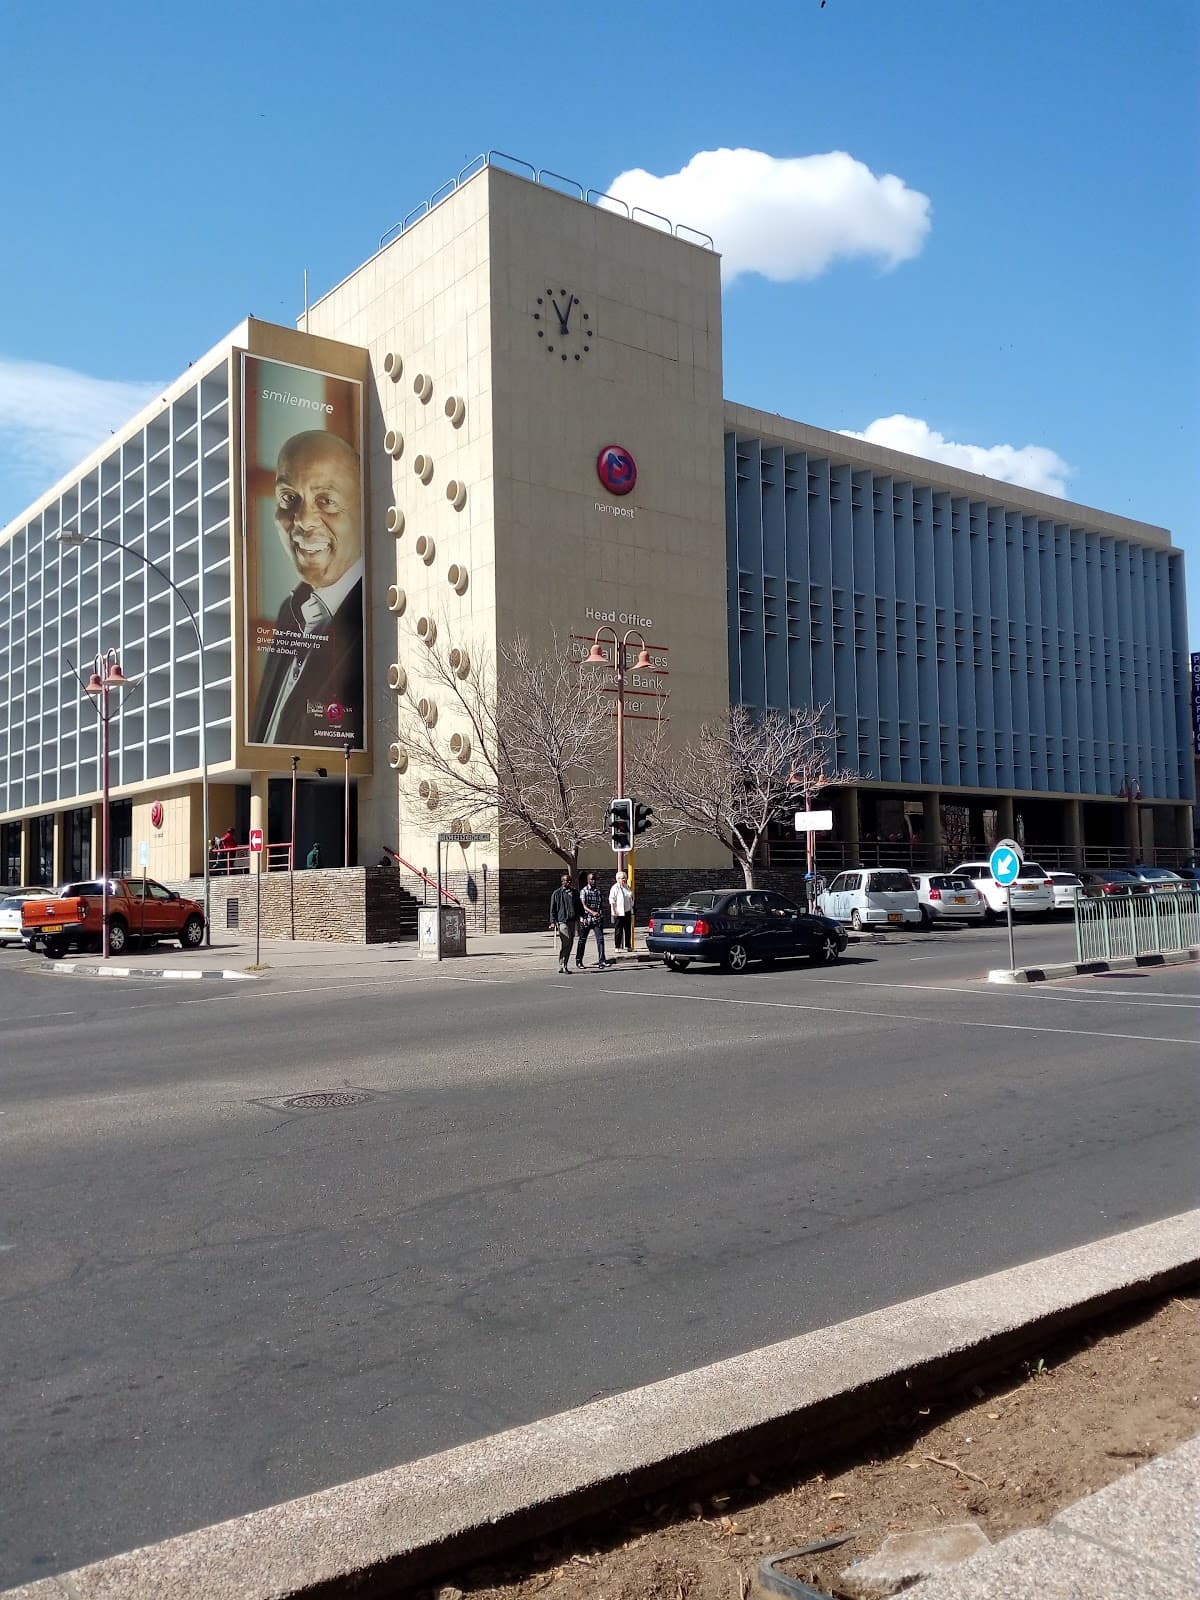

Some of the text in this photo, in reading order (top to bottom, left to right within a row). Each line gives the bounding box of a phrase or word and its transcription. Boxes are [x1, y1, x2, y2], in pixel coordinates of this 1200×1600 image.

[261, 389, 334, 414] smilemore
[594, 502, 634, 518] nampost
[585, 607, 653, 627] Head Office
[256, 627, 271, 635] Our
[272, 628, 302, 638] Tax-Free
[256, 636, 275, 645] gives
[290, 639, 312, 650] plenty
[256, 645, 298, 656] smile about.
[571, 643, 612, 661] Poal
[632, 674, 664, 690] Bank
